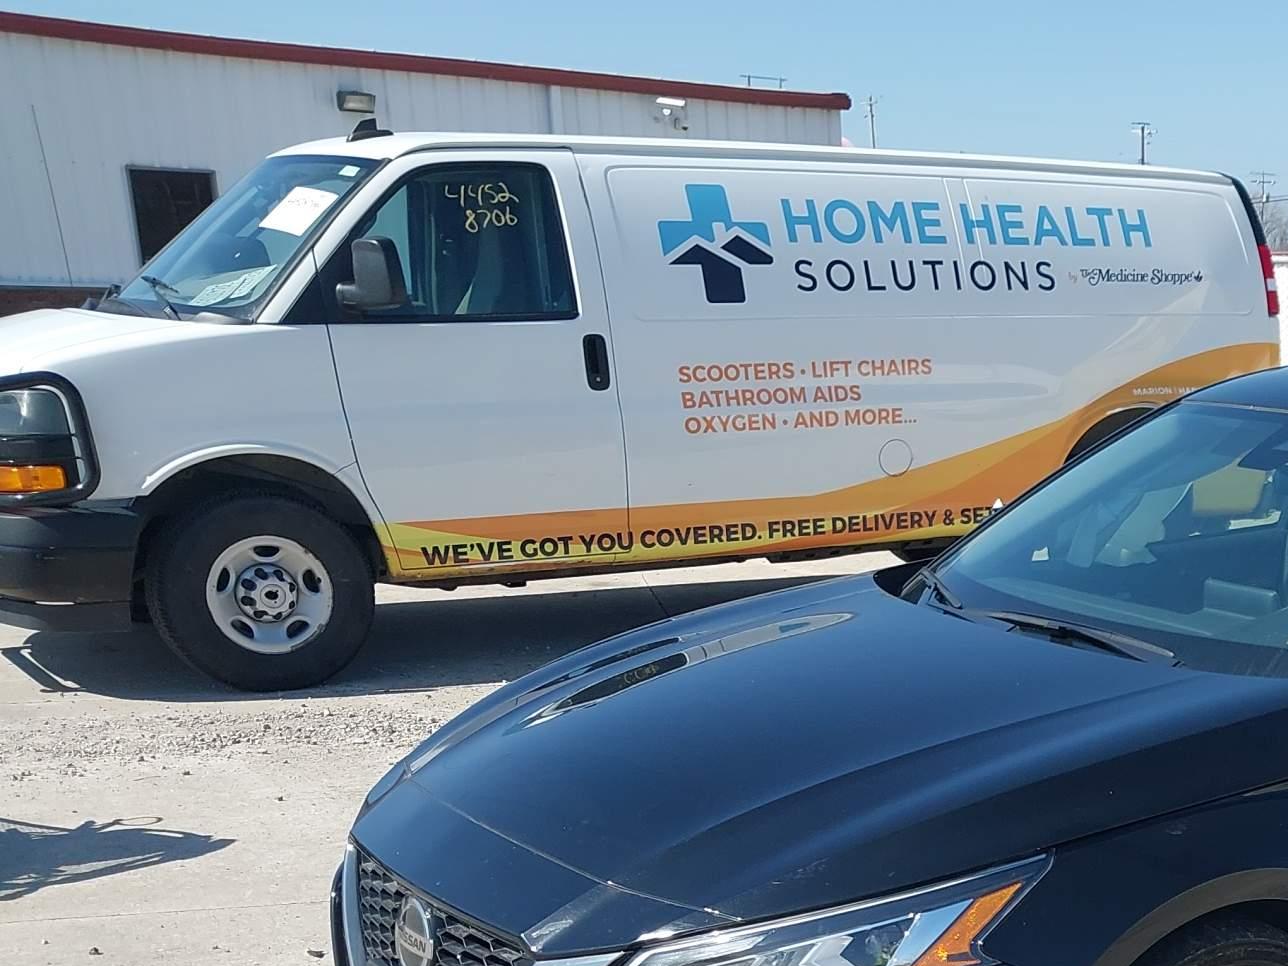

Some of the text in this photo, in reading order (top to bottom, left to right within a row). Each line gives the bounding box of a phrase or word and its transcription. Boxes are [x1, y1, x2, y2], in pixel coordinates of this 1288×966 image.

[444, 182, 519, 207] 4452
[465, 205, 518, 233] 8706
[780, 198, 1153, 248] HOME HEALTH
[794, 259, 1056, 292] SOLUTIONS
[1088, 268, 1149, 286] Medicine
[1150, 268, 1192, 285] Shoppe
[678, 358, 932, 384] SCOOTERS LIFT CHAIRS
[681, 385, 862, 409] BATHROOM AIDS
[684, 407, 917, 434] OXYGEN AND MORE...
[519, 535, 574, 558] GOT
[578, 531, 633, 553] YOU
[639, 522, 762, 549] COVERED.
[767, 517, 826, 539] FREE
[831, 509, 937, 535] DELIVERY
[942, 508, 955, 526] &
